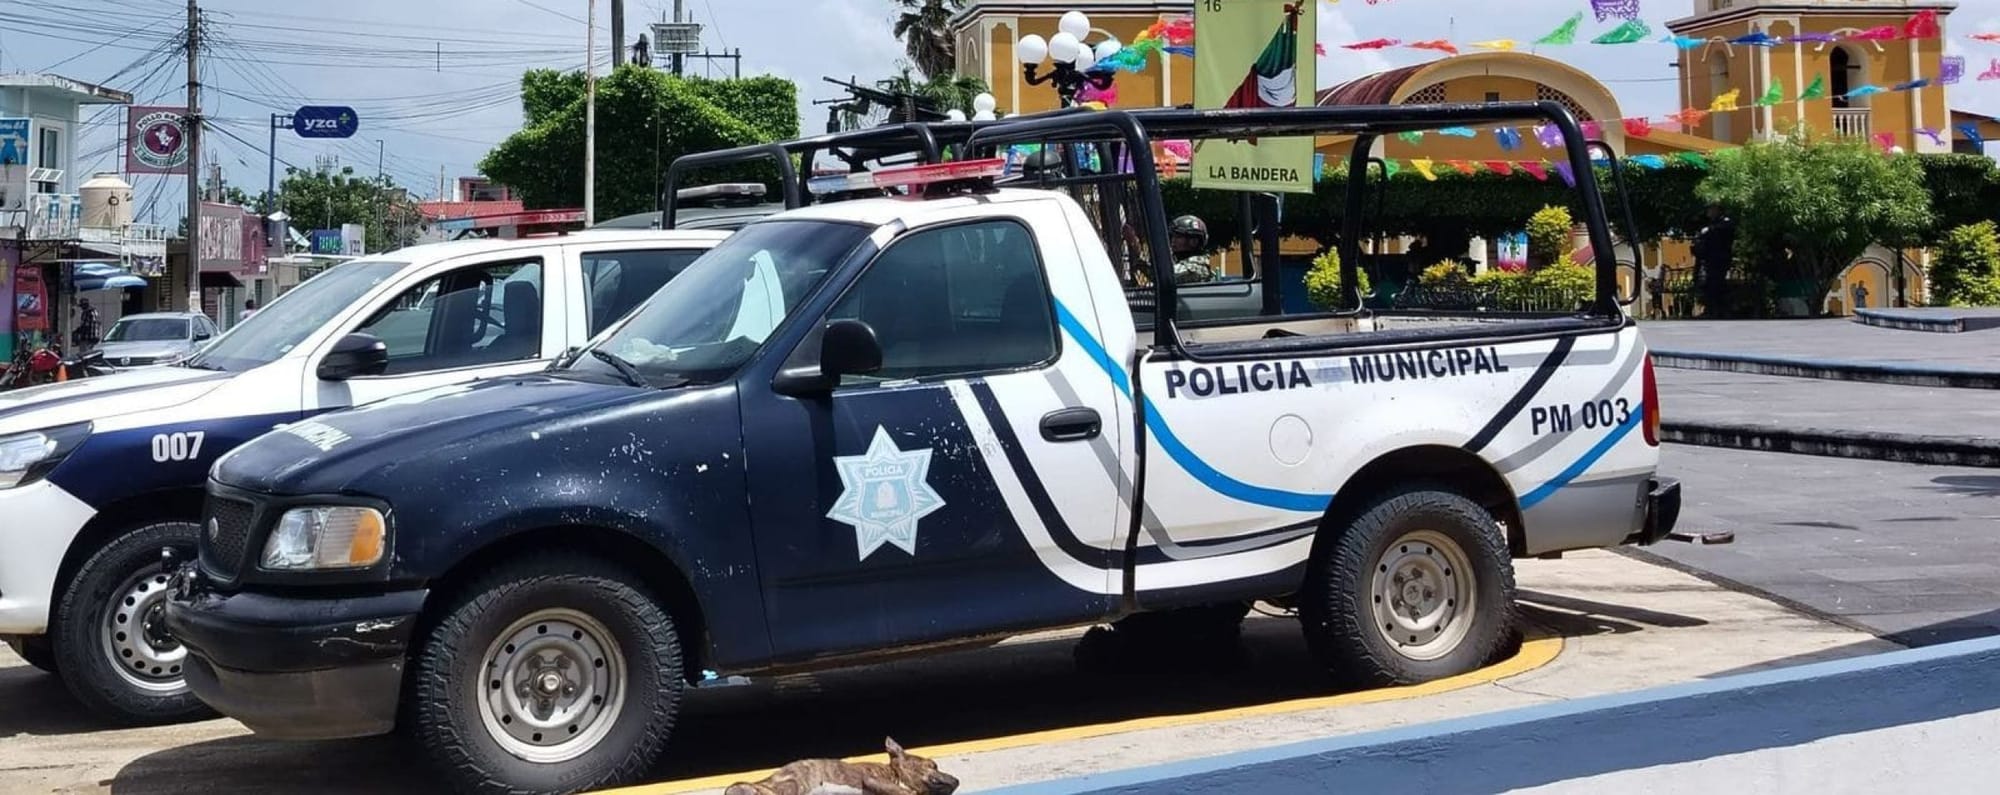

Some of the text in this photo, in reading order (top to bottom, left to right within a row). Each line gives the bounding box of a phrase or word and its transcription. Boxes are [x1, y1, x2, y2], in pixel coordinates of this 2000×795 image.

[1204, 0, 1222, 13] 16
[138, 113, 162, 128] POLLO
[304, 119, 338, 131] yza
[1209, 166, 1299, 183] LA BANDERA
[1165, 346, 1510, 399] POLICIA MUNICIPAL
[1531, 397, 1631, 436] PM 003
[152, 431, 205, 463] 007
[864, 464, 904, 477] POLICIA
